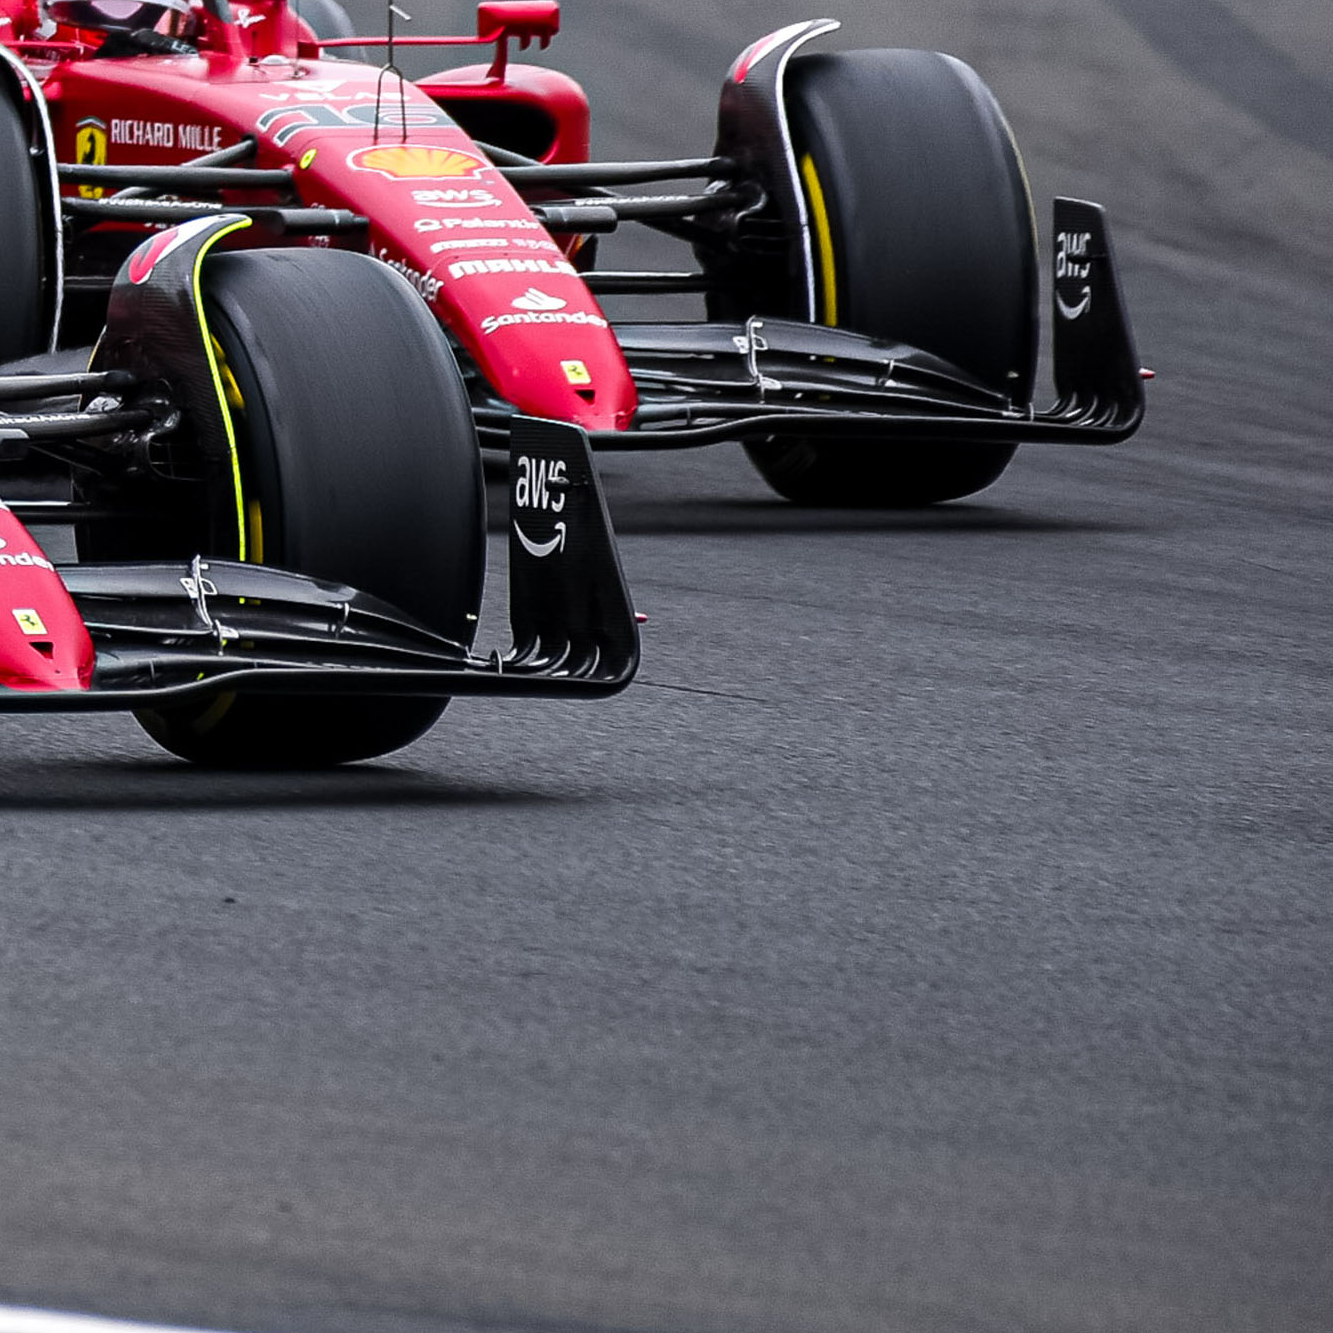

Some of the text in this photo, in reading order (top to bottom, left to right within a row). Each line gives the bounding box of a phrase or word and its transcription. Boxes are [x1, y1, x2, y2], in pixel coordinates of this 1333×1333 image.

[110, 118, 222, 152] RICHARD MILLE
[480, 310, 609, 335] Santander
[515, 455, 567, 513] aws
